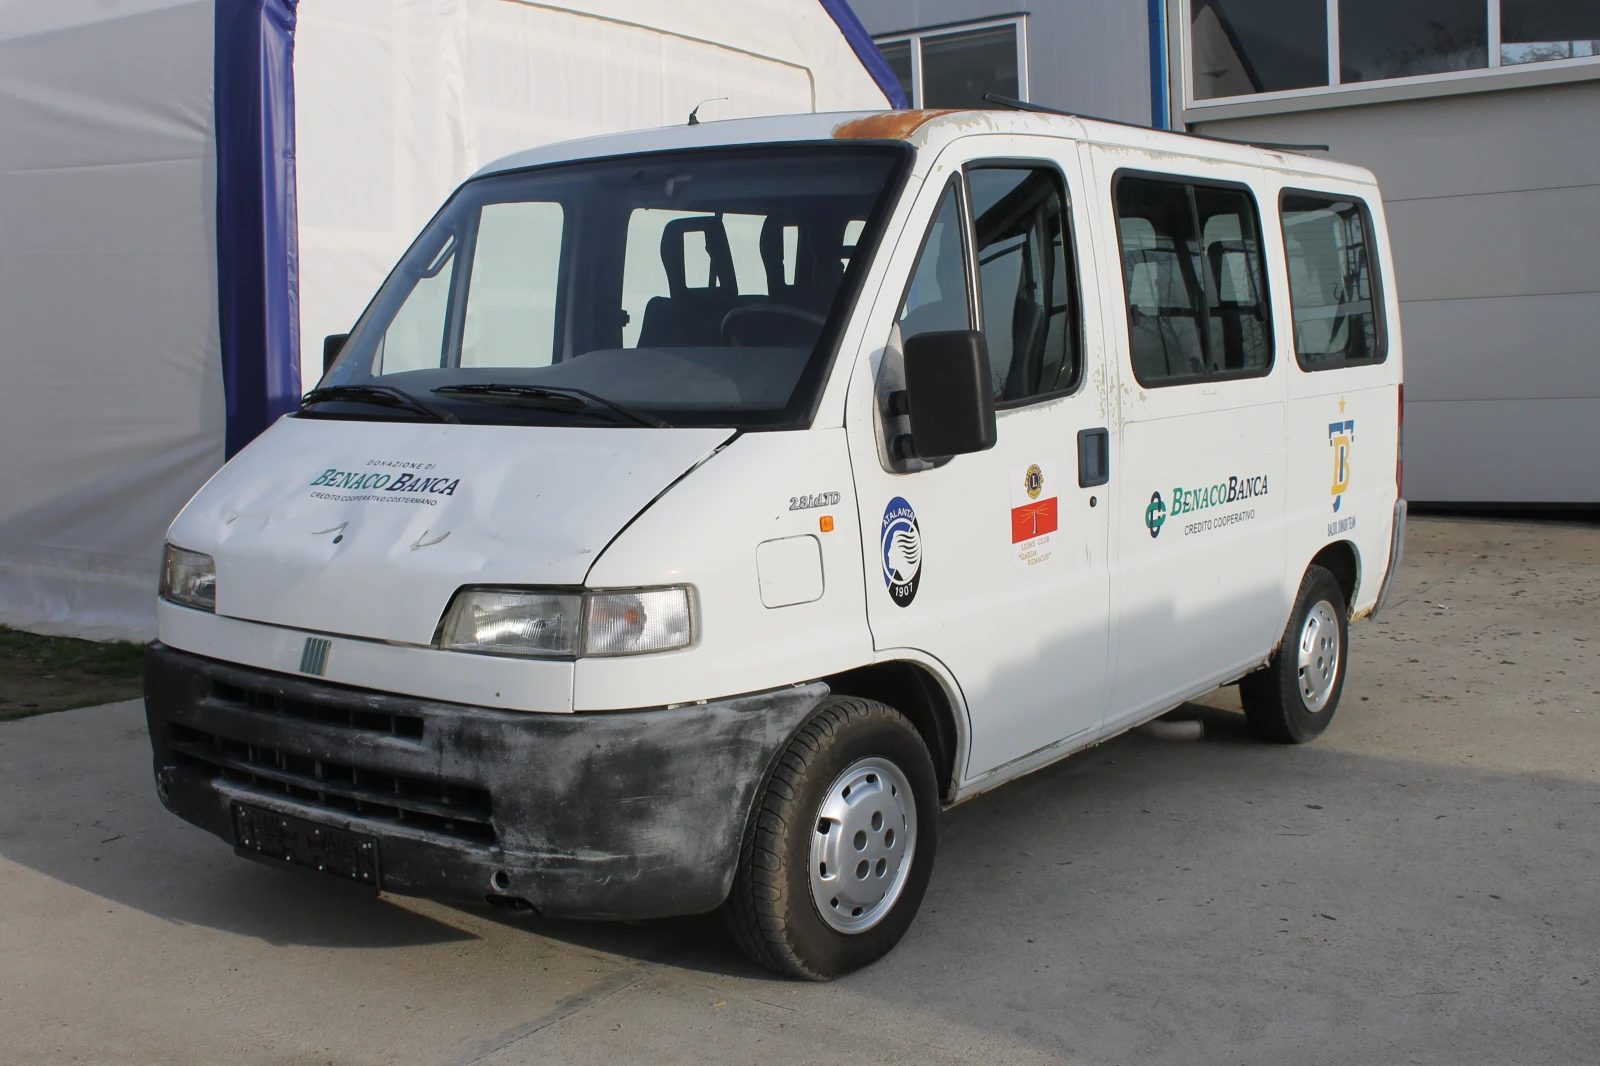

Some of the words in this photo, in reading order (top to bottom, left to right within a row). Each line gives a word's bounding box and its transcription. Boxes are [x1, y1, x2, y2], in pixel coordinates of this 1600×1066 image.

[366, 460, 422, 470] DONAZIONE
[310, 492, 340, 501] CREDITO
[341, 495, 386, 503] COOPERATIVO
[386, 496, 438, 507] COSTERMANO
[882, 507, 914, 528] ATALANTA
[1184, 519, 1212, 536] CREDITO
[1213, 509, 1256, 529] COOPERATIVO
[1021, 540, 1035, 551] LIONS
[1037, 536, 1049, 545] CLUB
[894, 583, 913, 598] 1907
